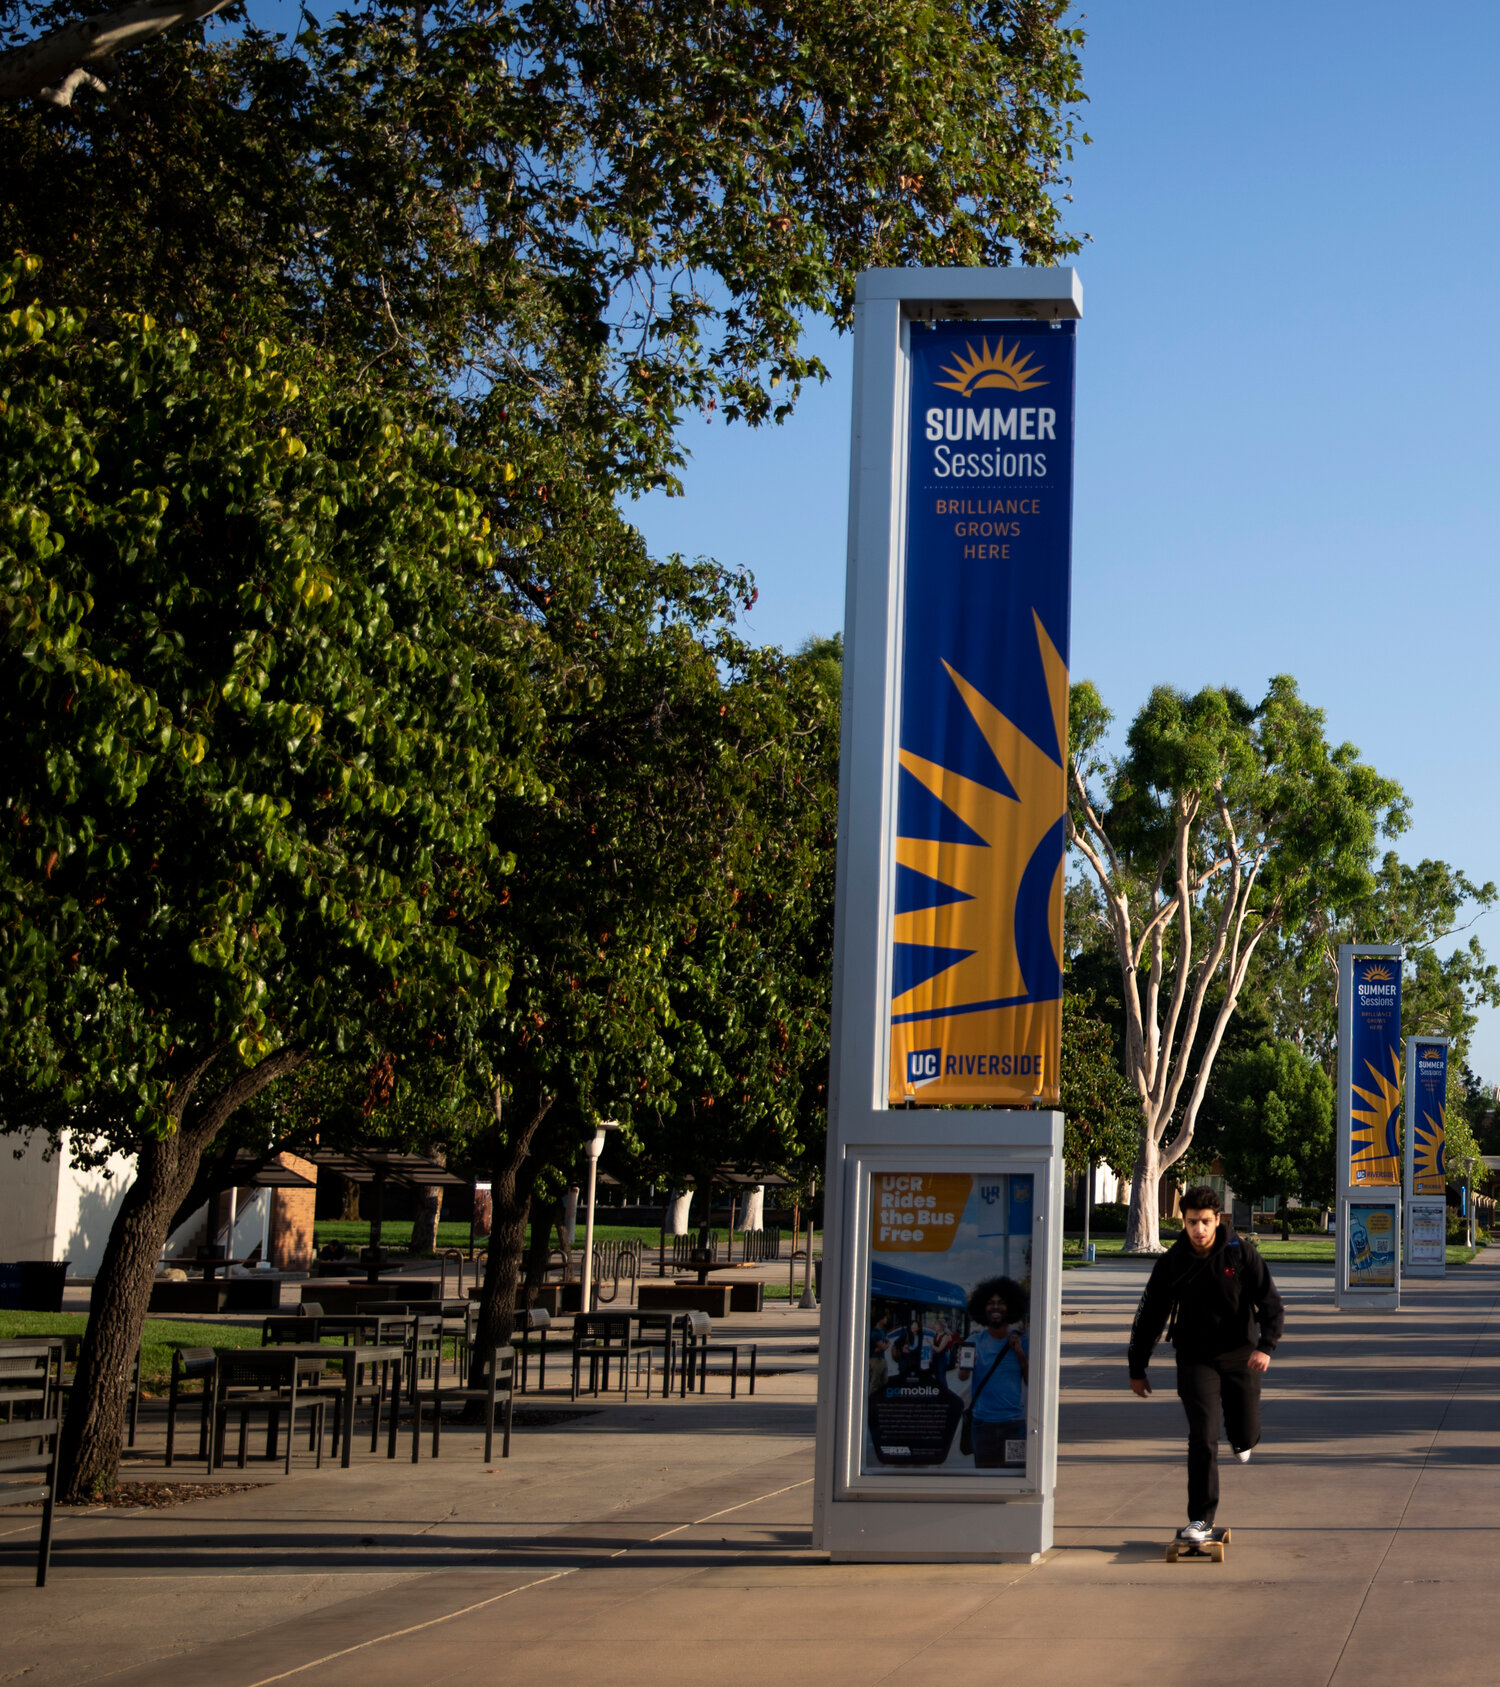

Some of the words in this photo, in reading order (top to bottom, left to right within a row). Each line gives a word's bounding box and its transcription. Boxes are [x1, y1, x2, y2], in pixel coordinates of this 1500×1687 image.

[925, 407, 1056, 441] SUMMER
[933, 444, 1047, 478] Sessions
[936, 499, 1041, 514] BRILLIANCE
[954, 521, 1021, 537] GROWS
[964, 544, 1011, 559] HERE
[1358, 984, 1397, 996] SUMMER
[1360, 995, 1394, 1006] Sessions
[911, 1054, 937, 1076] UC
[945, 1054, 1043, 1076] RIVERSIDE
[1418, 1060, 1444, 1069] SUMMER
[1357, 1170, 1366, 1178] UC
[881, 1176, 923, 1191] UCR
[880, 1191, 937, 1208] Rides
[880, 1208, 915, 1225] the
[917, 1209, 955, 1225] Bus
[879, 1226, 924, 1242] Free
